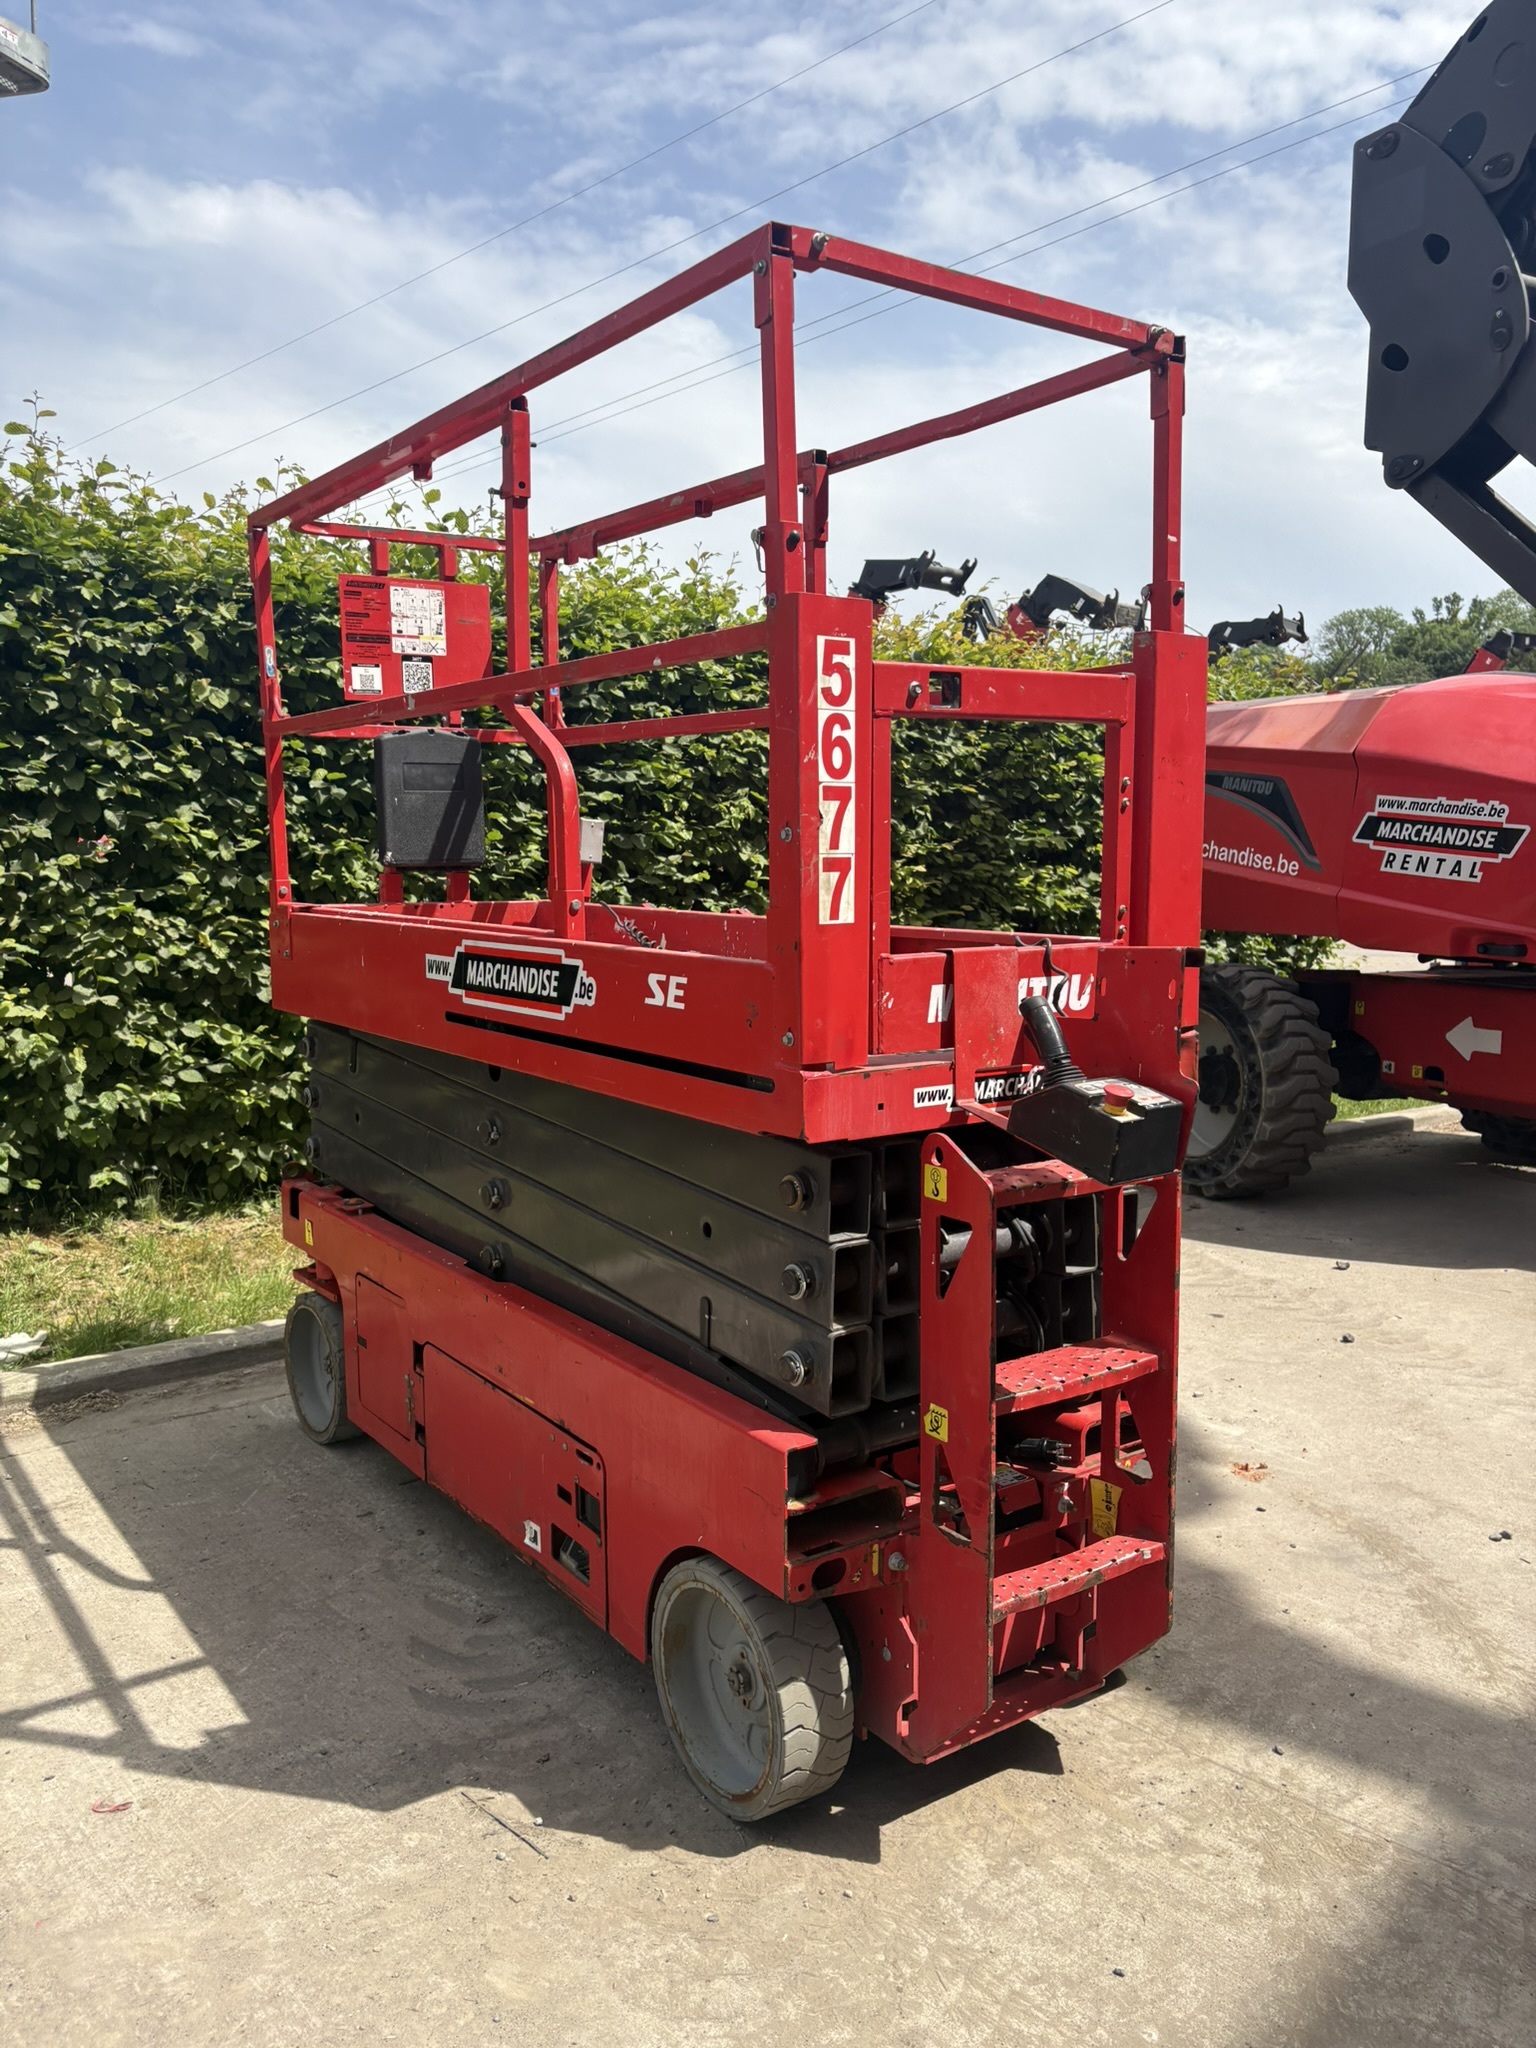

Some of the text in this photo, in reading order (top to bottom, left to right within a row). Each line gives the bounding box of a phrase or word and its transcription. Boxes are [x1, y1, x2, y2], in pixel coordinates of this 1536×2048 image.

[821, 639, 852, 921] 5677
[1221, 776, 1275, 796] MANITOU
[1378, 798, 1506, 819] www.marchandise.be
[1376, 820, 1499, 849] MARCHANDISE
[1384, 852, 1480, 879] RENTAL
[466, 959, 560, 998] MARCHANDISE
[644, 972, 688, 1010] SE
[927, 973, 1095, 1024] MITOU
